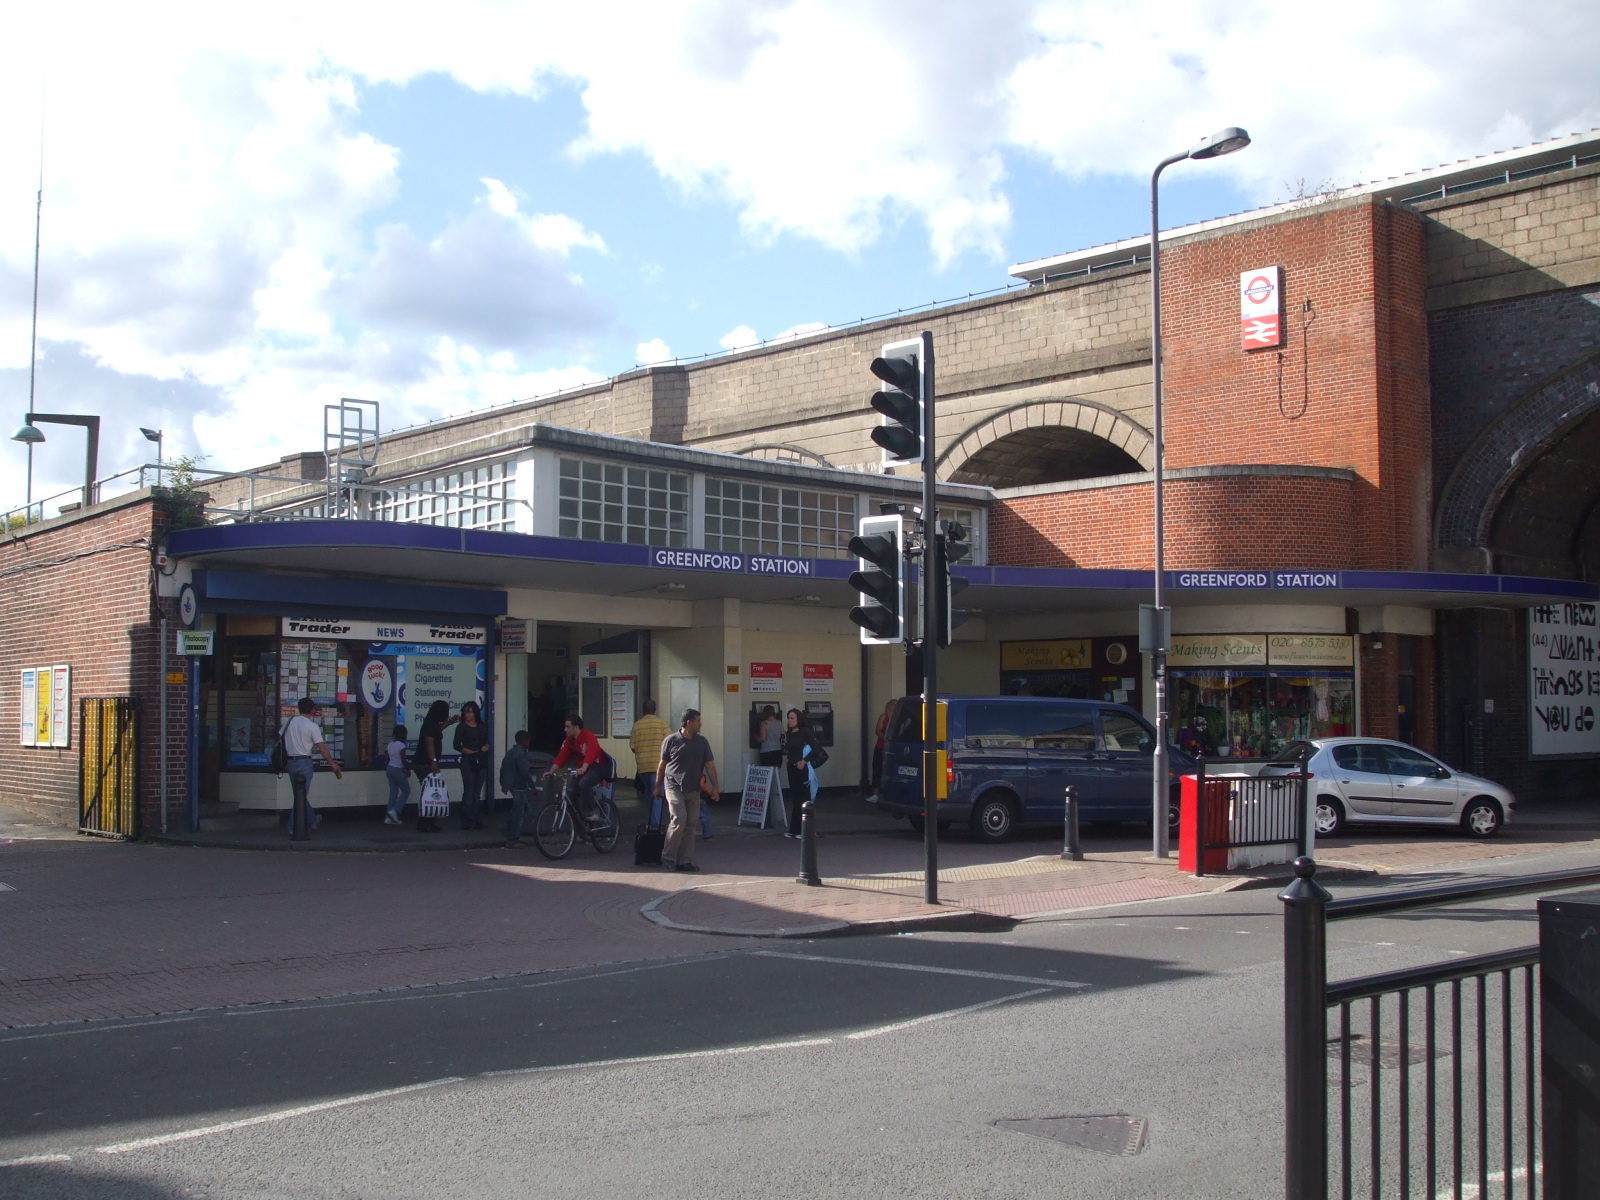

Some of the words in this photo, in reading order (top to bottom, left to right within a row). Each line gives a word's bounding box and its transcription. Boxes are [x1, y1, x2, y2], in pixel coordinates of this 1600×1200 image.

[1246, 286, 1273, 294] UNDERGROUND
[655, 550, 742, 570] GREENFORD
[751, 557, 810, 575] STATION
[1179, 573, 1267, 587] GREENFORD
[1276, 573, 1337, 587] STATION
[289, 622, 351, 634] Trader
[376, 627, 405, 638] NEWS
[184, 634, 209, 644] Photocopy
[429, 629, 484, 640] Trader
[1271, 637, 1294, 648] 020
[1301, 638, 1326, 649] 8575
[1329, 638, 1350, 649] 5330
[1532, 633, 1549, 648] (A4)
[394, 645, 414, 654] oyster
[416, 645, 436, 654] Ticket
[437, 647, 452, 655] Stop
[1015, 646, 1050, 657] Making
[1171, 643, 1218, 659] Making
[1220, 642, 1263, 657] Scents
[415, 661, 455, 673] Magazines
[752, 664, 764, 672] Free
[415, 673, 453, 685] Cigarettes
[415, 688, 452, 699] Stationery
[744, 798, 764, 808] OPEN
